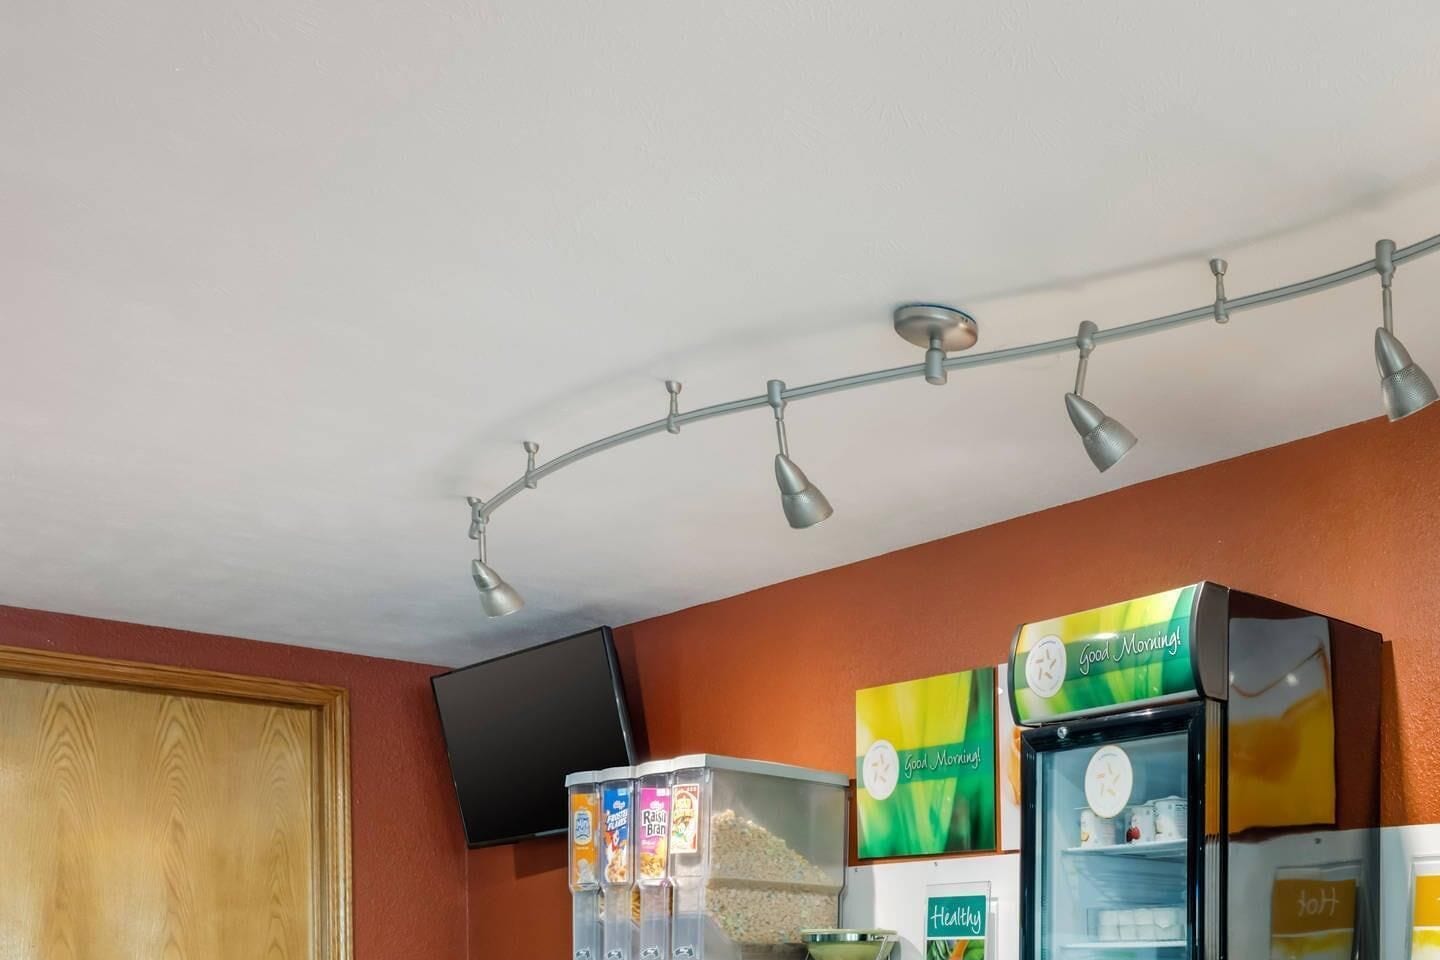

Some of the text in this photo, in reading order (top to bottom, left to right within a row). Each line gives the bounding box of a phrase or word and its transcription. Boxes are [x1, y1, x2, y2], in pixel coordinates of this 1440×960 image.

[1079, 625, 1182, 676] Good Morning!
[904, 746, 981, 779] Good Morning!
[647, 824, 666, 836] Bran
[930, 905, 981, 934] Healthy
